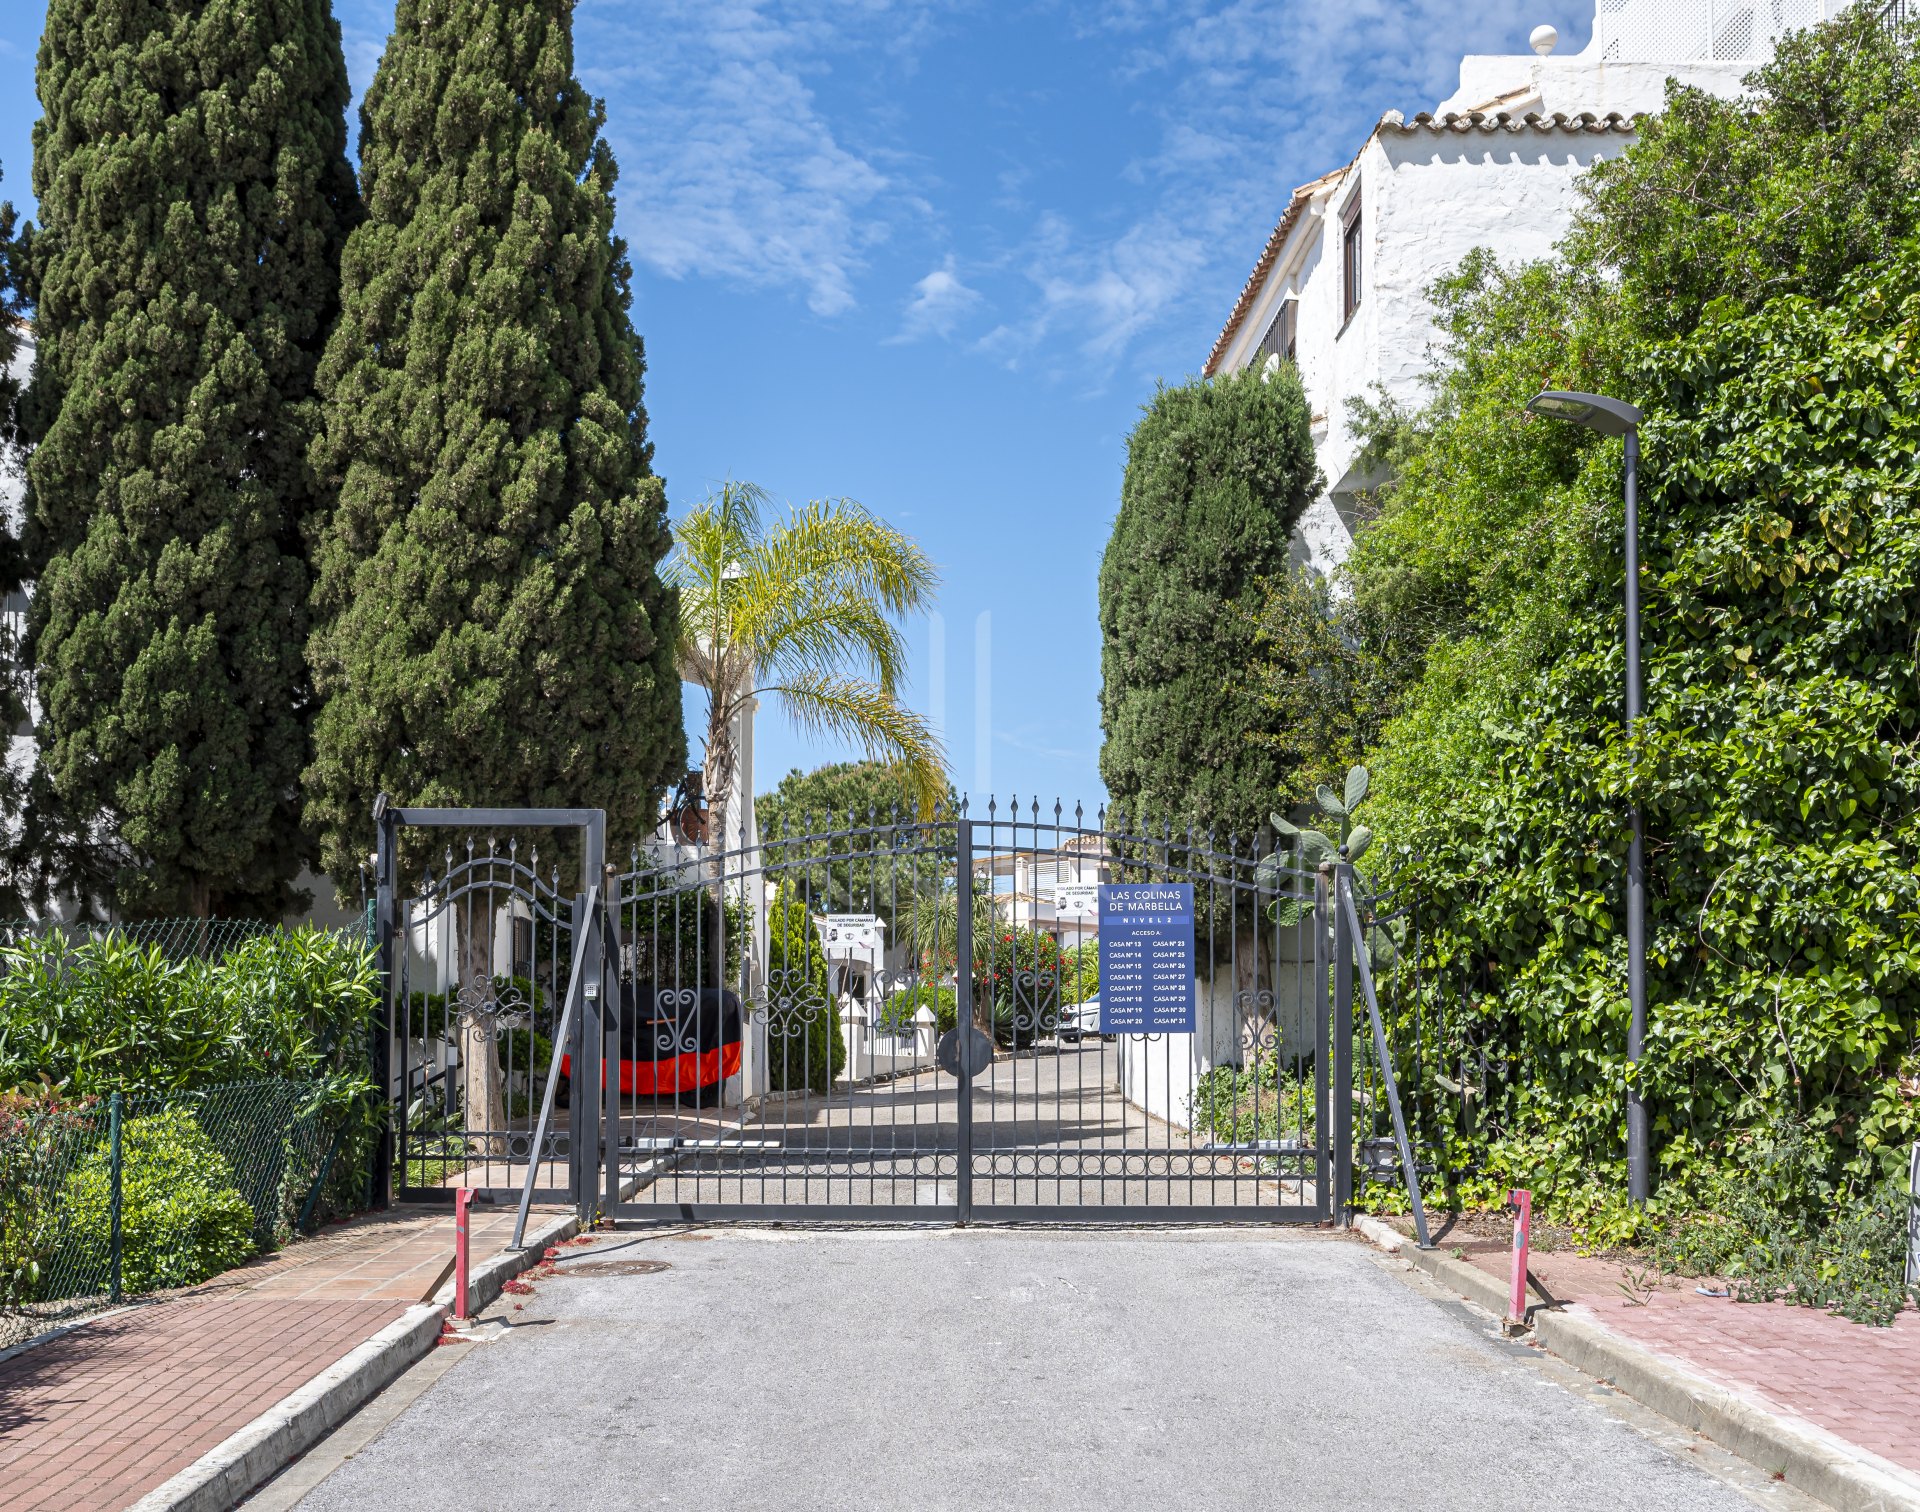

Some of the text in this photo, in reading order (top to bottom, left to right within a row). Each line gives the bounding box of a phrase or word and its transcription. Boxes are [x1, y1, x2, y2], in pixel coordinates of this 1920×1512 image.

[1111, 891, 1181, 900] LAS COLINAS
[1109, 902, 1182, 911] DE MARBELLA
